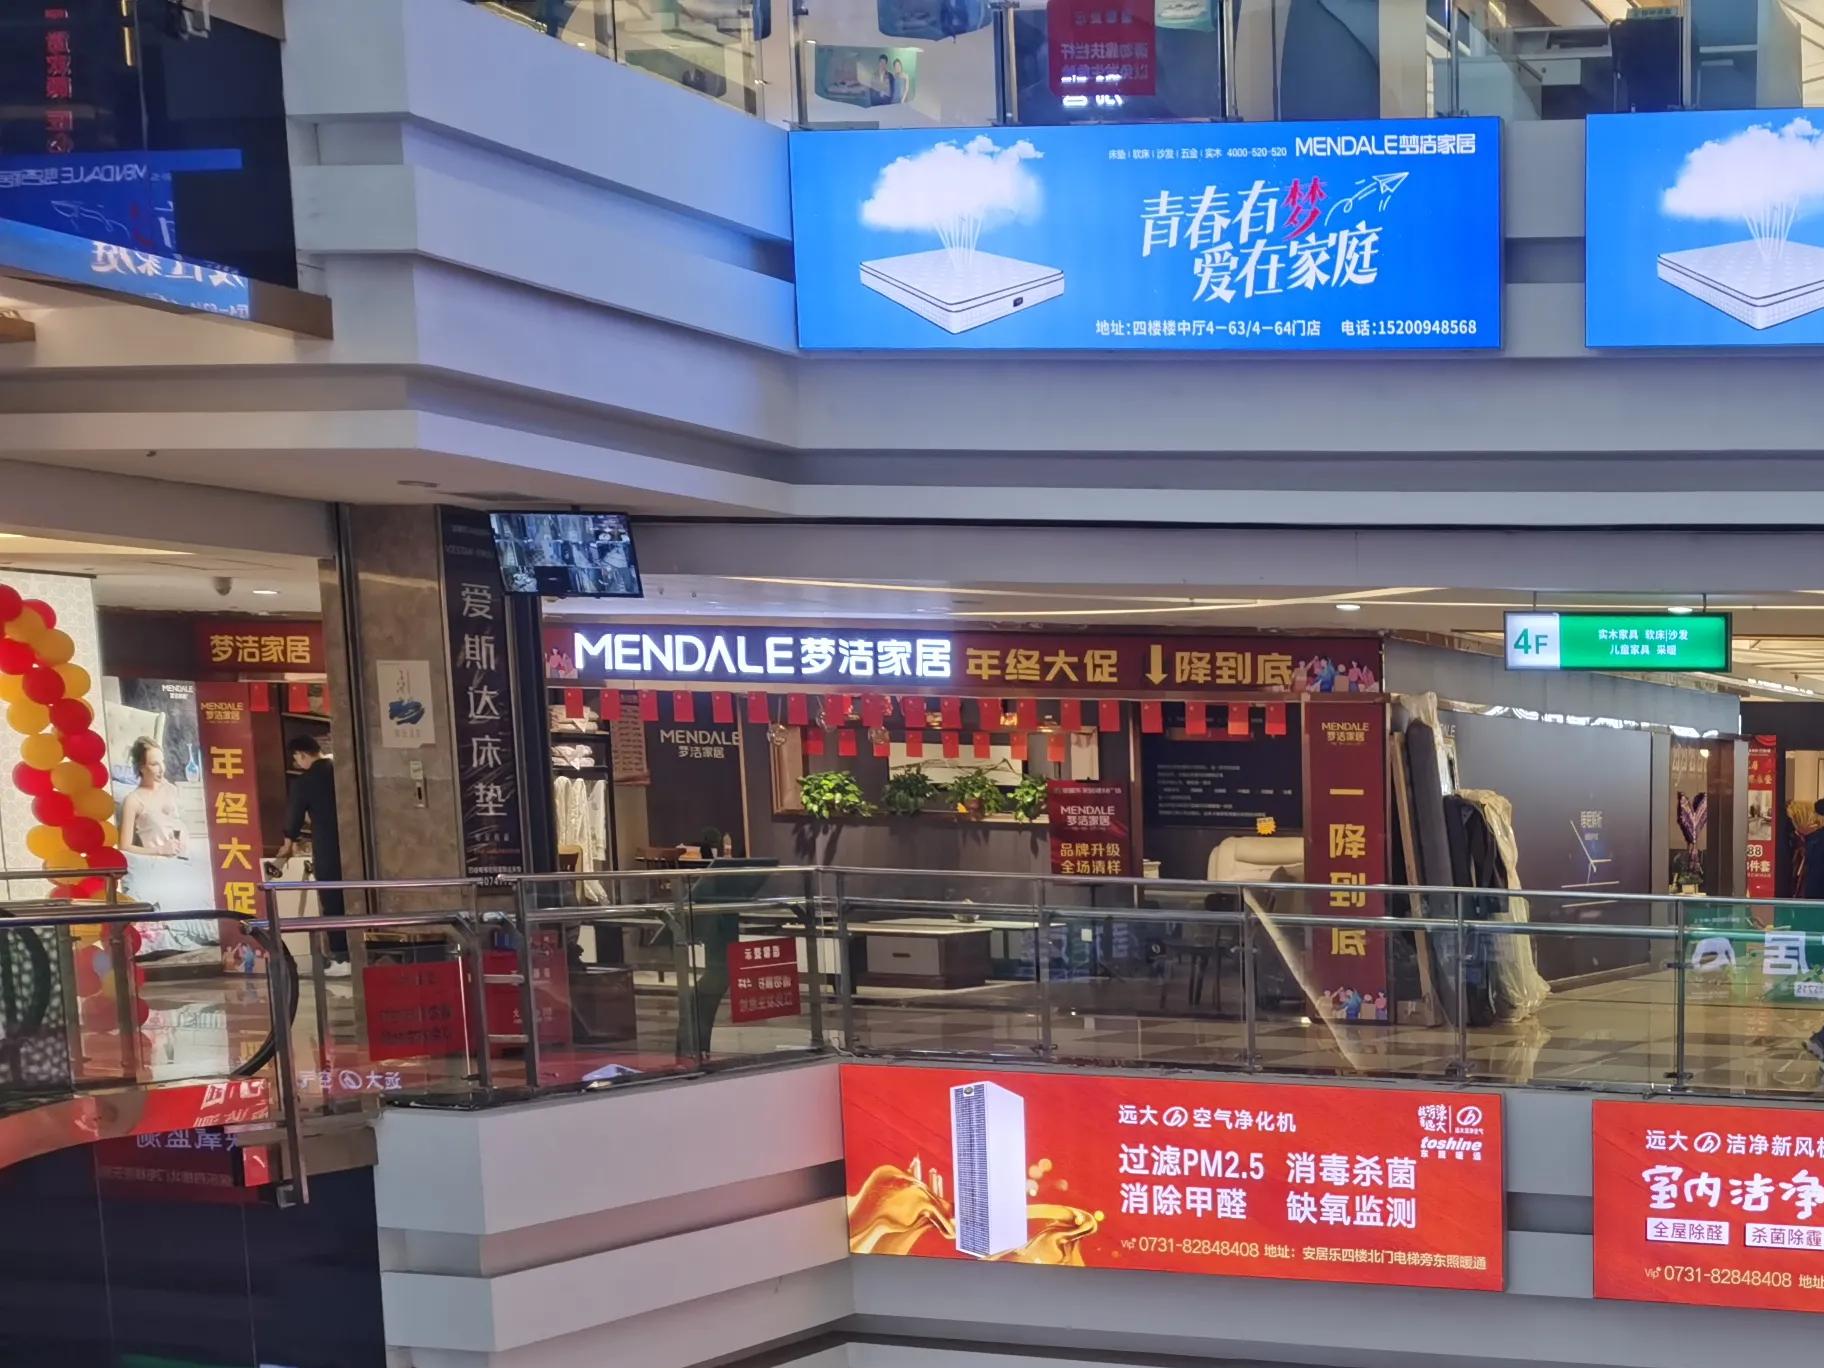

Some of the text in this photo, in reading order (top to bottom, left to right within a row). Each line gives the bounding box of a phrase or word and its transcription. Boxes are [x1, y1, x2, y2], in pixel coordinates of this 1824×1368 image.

[1140, 176, 1328, 257] 青春有梦
[1192, 220, 1383, 303] 爱在家庭
[210, 635, 310, 663] 梦洁家居
[1513, 628, 1548, 655] 4F
[966, 648, 1294, 686] 年终大促 降到底
[201, 702, 243, 711] MENDALE
[461, 583, 507, 816] 爱斯达床垫
[660, 730, 740, 746] MENDALE
[1321, 722, 1370, 732] MENDALE
[678, 746, 725, 759] 梦洁家居
[1060, 805, 1115, 816] MENDALE
[210, 746, 257, 915] 年终大促
[1060, 843, 1121, 859] 品牌升级
[1329, 788, 1366, 956] 一降到底
[1118, 1105, 1296, 1133] 远大 空气净化机
[1421, 1137, 1482, 1151] toshine
[1645, 1130, 1688, 1151] 远大
[1118, 1144, 1418, 1190] 过滤PM2.5 消毒杀菌
[1119, 1183, 1417, 1229] 消除甲醛 缺氧监测
[1139, 1236, 1260, 1258] 0731-82848408
[1653, 1222, 1723, 1240] 全屋除醛
[1751, 1227, 1823, 1248] 杀菌除霾
[1664, 1265, 1792, 1288] 0731-82848408
